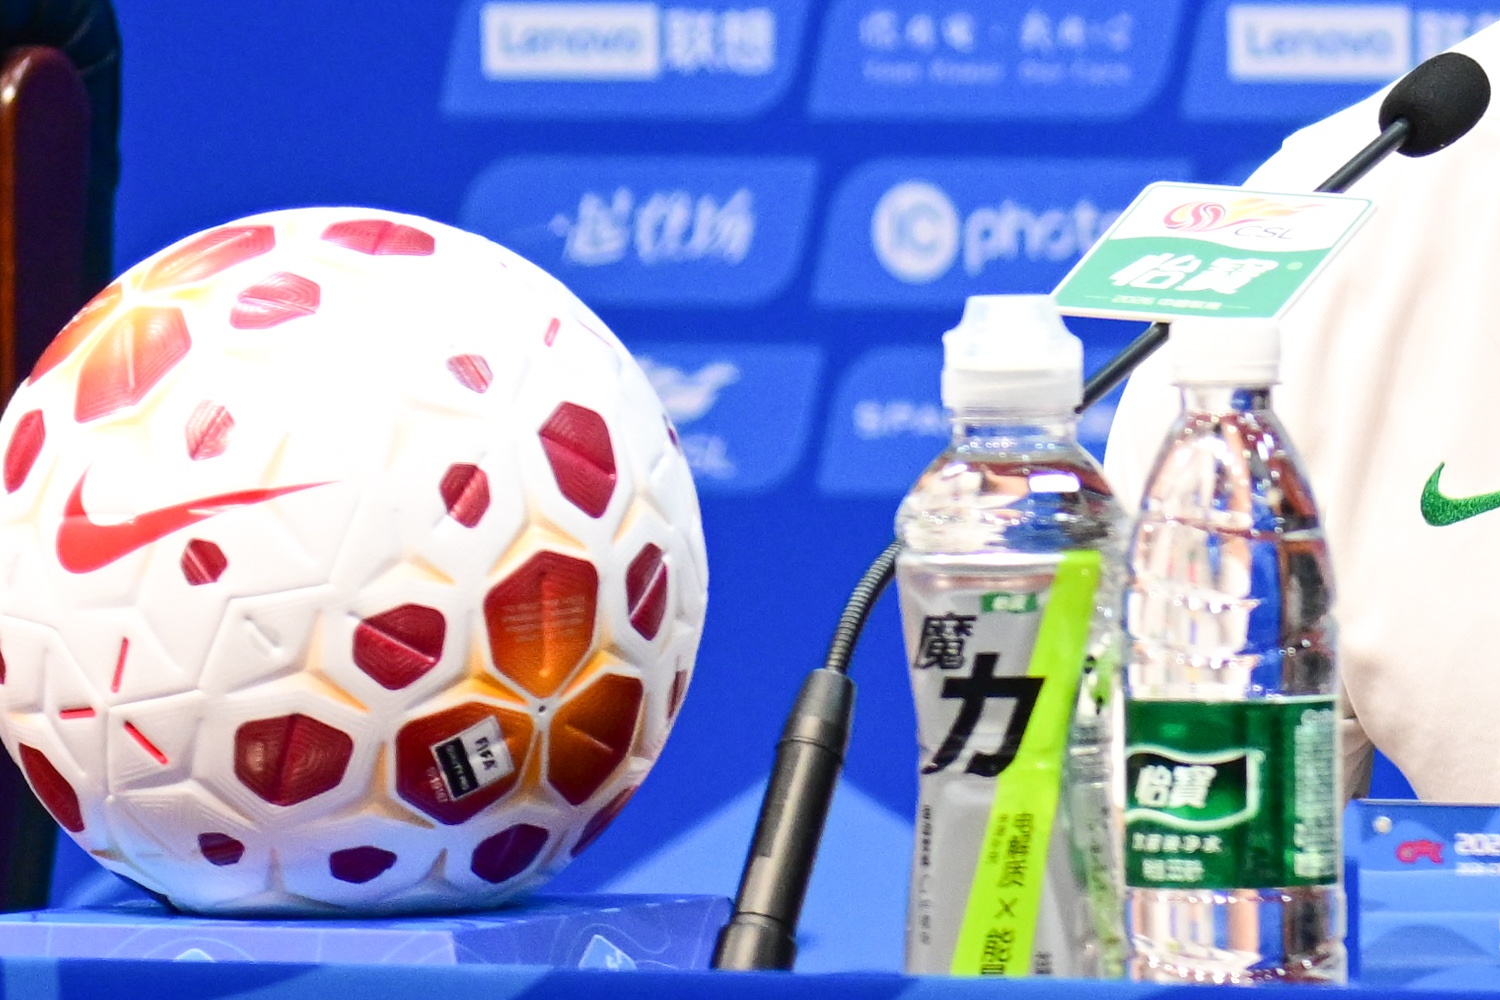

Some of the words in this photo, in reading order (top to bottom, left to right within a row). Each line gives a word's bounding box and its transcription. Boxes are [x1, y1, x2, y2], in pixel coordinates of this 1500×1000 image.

[501, 14, 644, 56] Lenovo
[1244, 18, 1395, 59] Lenovo
[1234, 224, 1296, 241] CSL
[474, 736, 498, 771] FIFA
